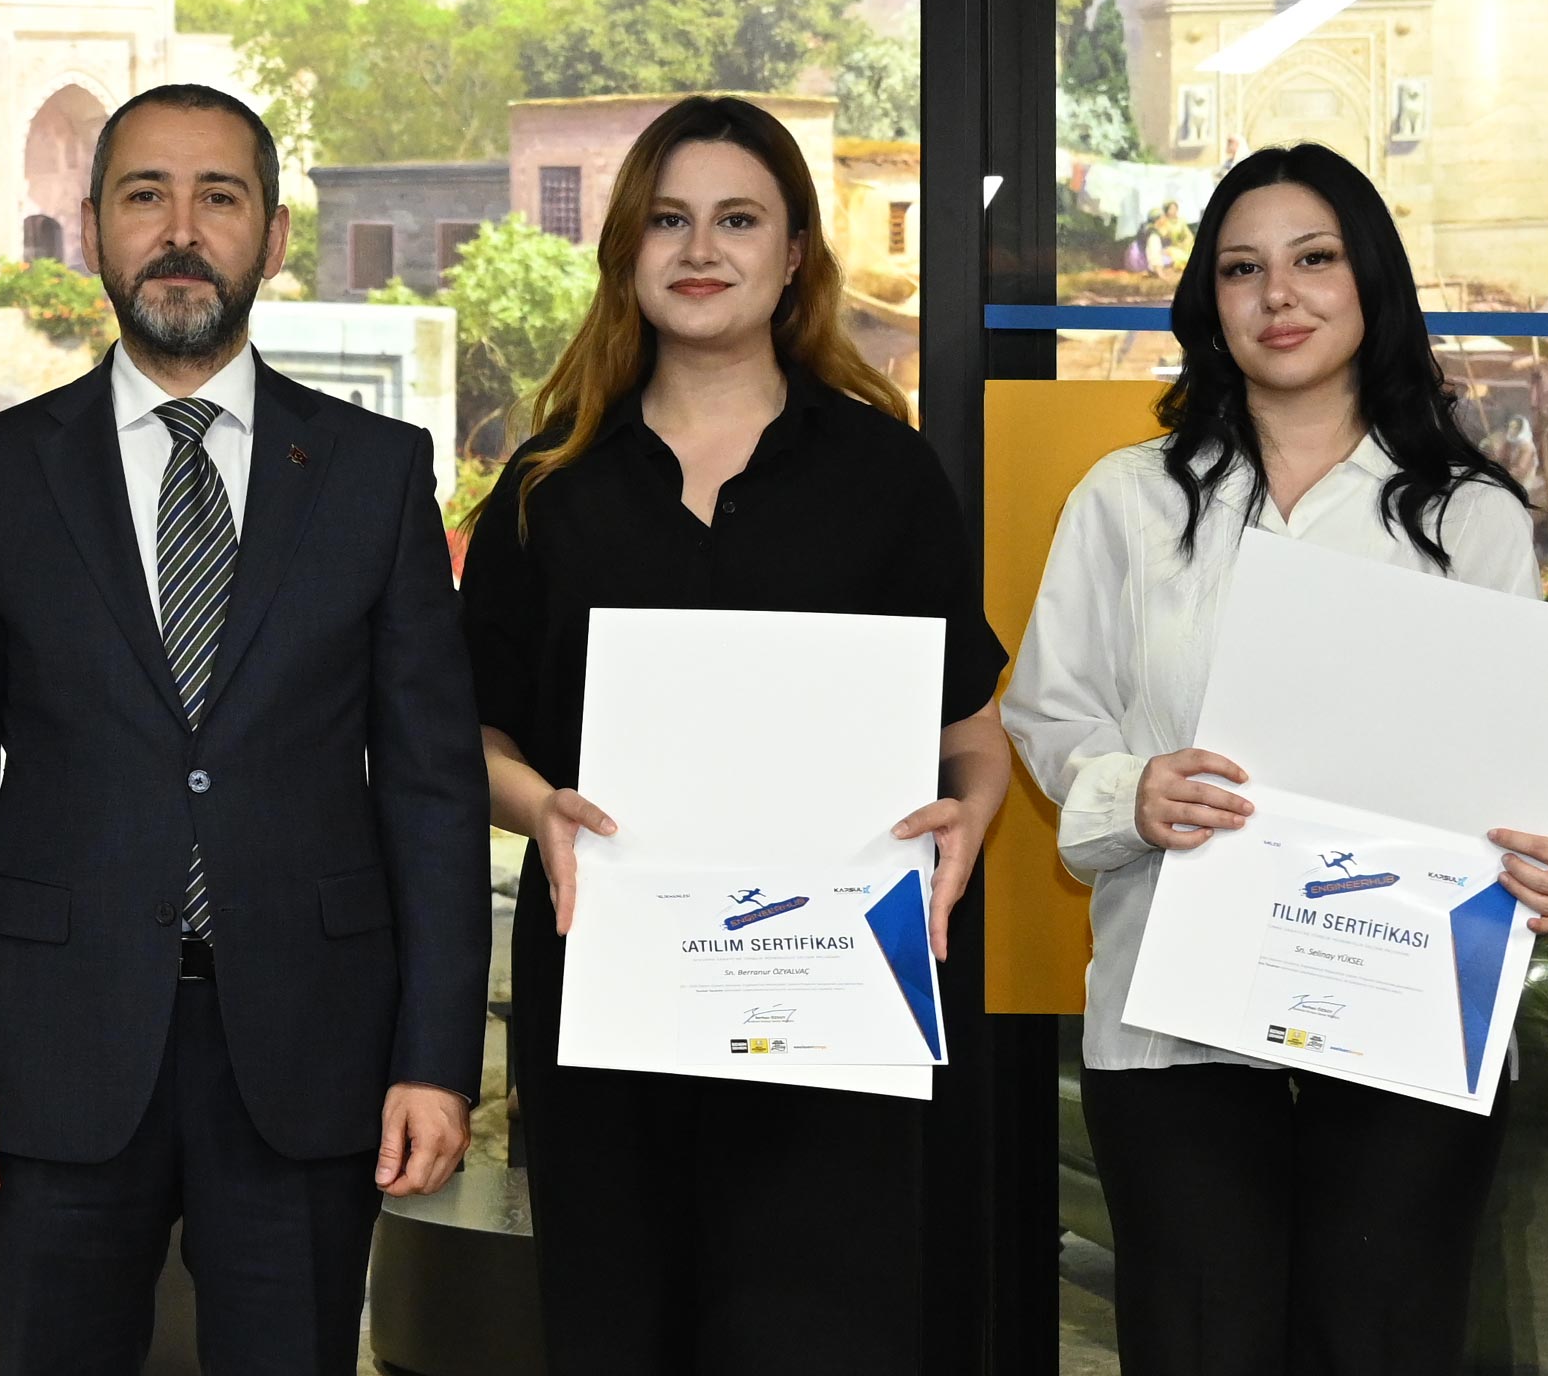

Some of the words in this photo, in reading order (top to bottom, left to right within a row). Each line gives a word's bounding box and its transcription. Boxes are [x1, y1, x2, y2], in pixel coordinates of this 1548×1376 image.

[1310, 874, 1396, 894] ENGINEERHUB
[1322, 913, 1430, 949] SERTİFİKASI
[750, 934, 855, 952] SERTİFİKASI
[1308, 947, 1336, 961] Selinay
[1336, 950, 1365, 966] YÜKSEL
